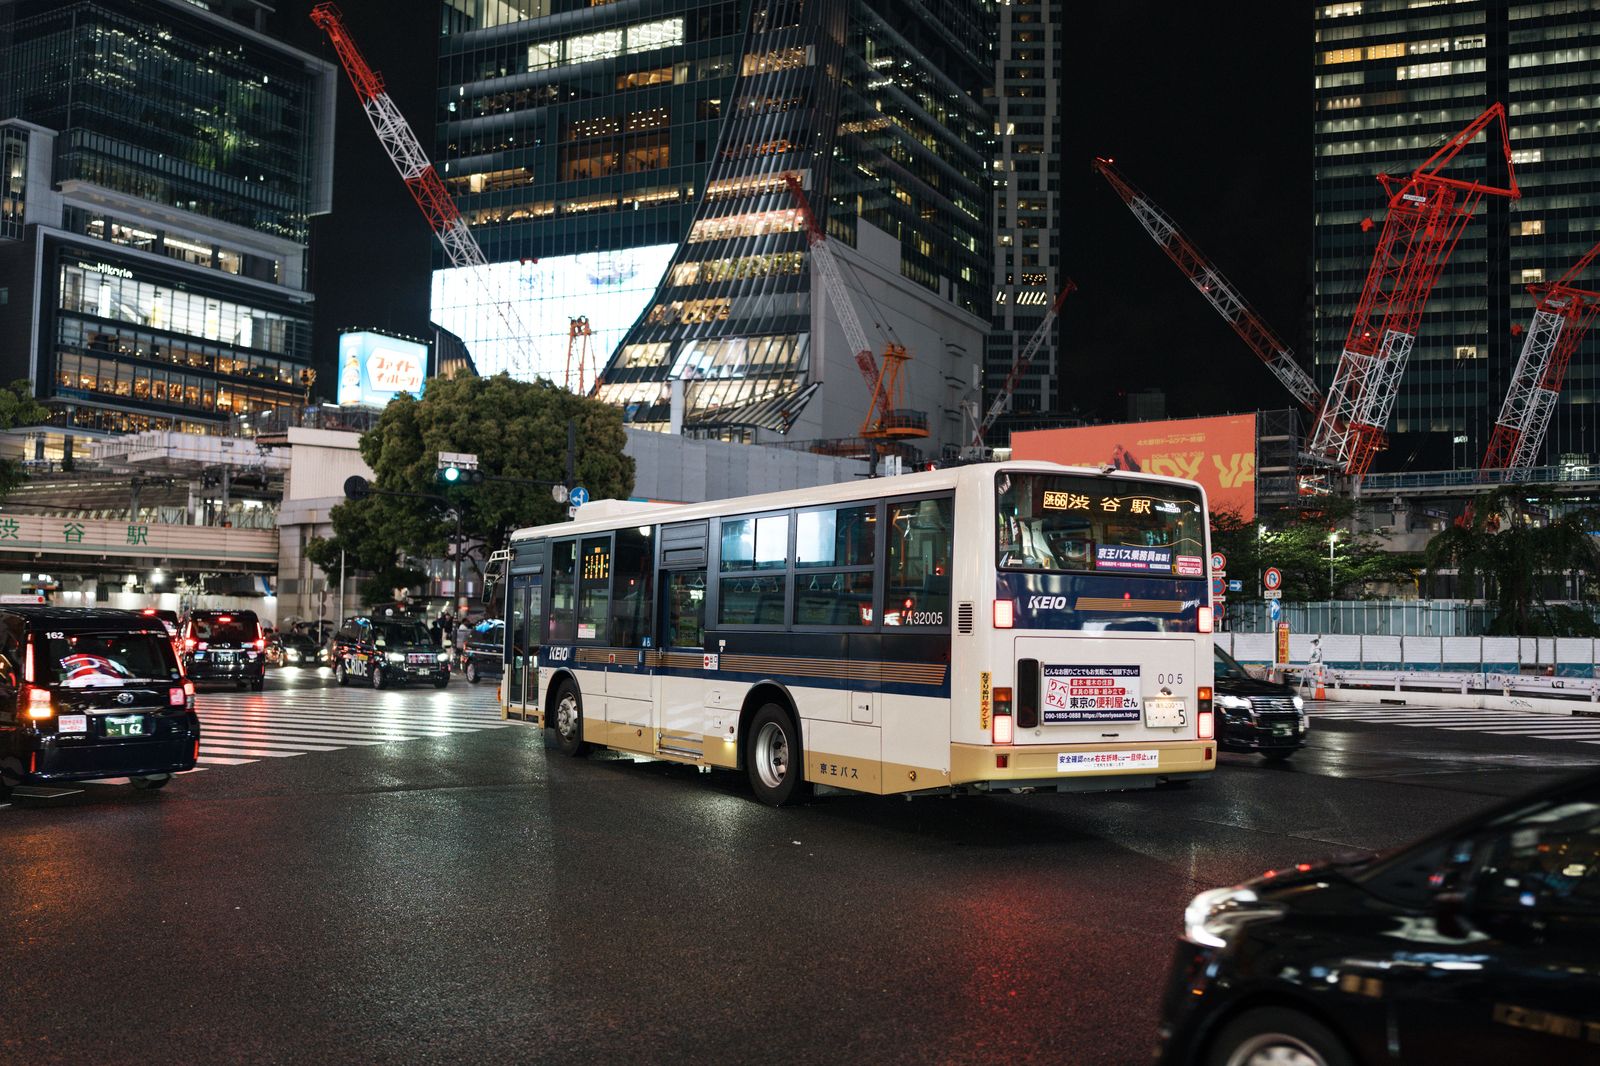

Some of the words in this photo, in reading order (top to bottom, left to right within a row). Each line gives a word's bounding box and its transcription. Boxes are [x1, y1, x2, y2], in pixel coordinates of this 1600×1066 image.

[97, 262, 133, 279] Hikarie
[1068, 494, 1151, 514] 渋谷駅
[0, 518, 149, 546] 渋谷駅
[1028, 596, 1066, 609] KEIO
[905, 610, 943, 625] A32005
[549, 646, 568, 661] KEIO
[1158, 673, 1183, 684] 005
[1070, 696, 1138, 709] 東京の便利屋さん
[1178, 709, 1187, 725] 5
[820, 763, 858, 780] 京王バス
